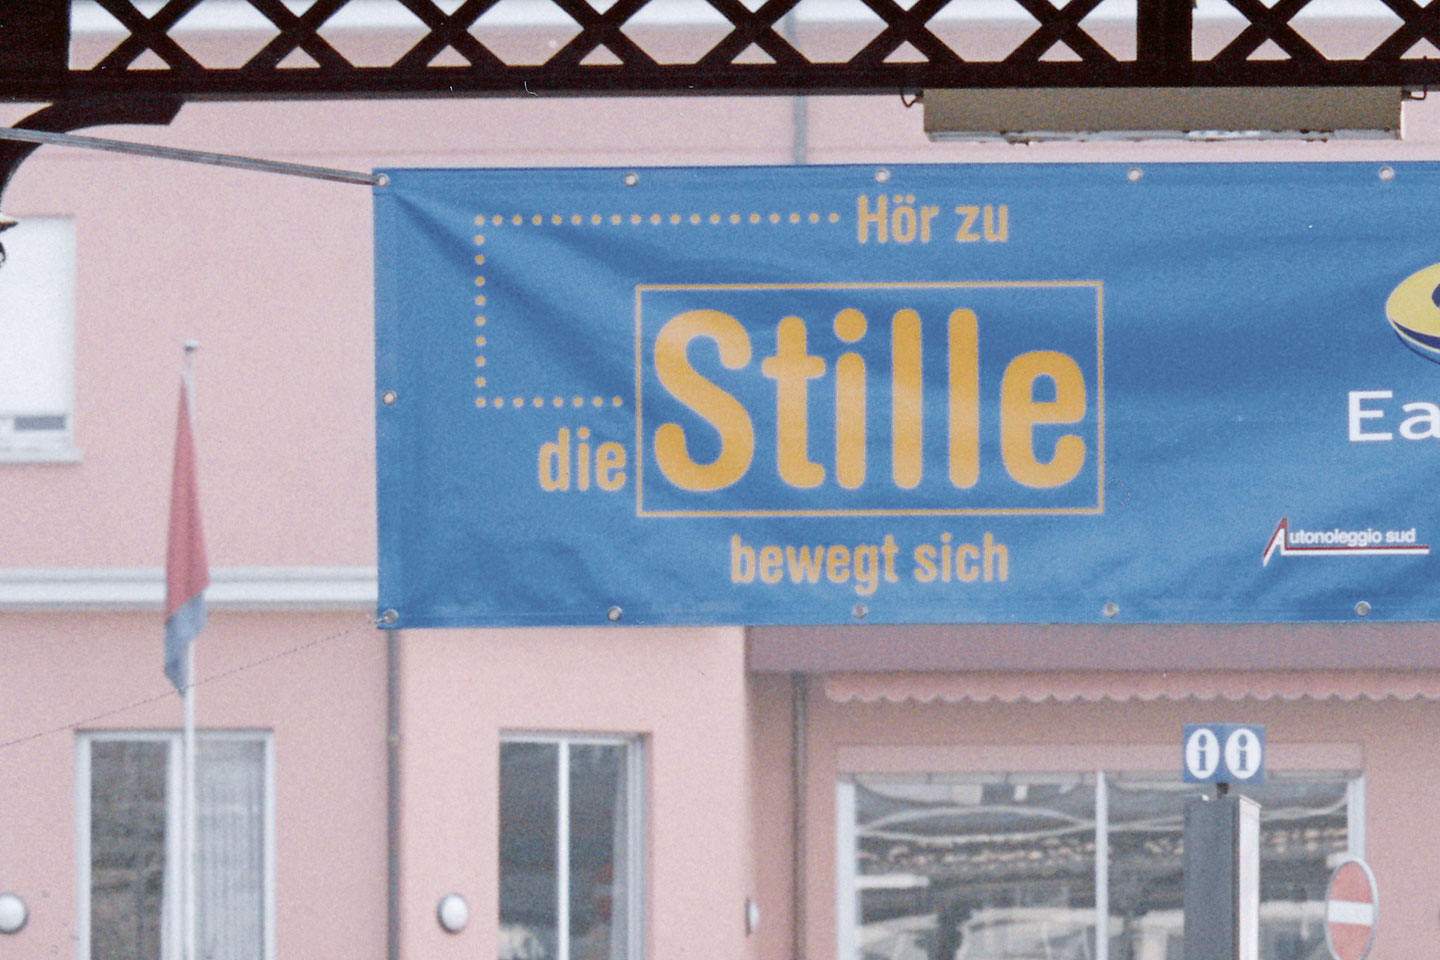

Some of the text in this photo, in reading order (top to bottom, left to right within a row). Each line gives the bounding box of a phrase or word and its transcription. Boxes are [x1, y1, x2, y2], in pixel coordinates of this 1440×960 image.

[857, 194, 1010, 244] Hör zu
[653, 307, 1088, 493] Stille
[537, 426, 628, 492] die
[730, 531, 1009, 596] bewegt sich
[1385, 527, 1417, 543] sud
